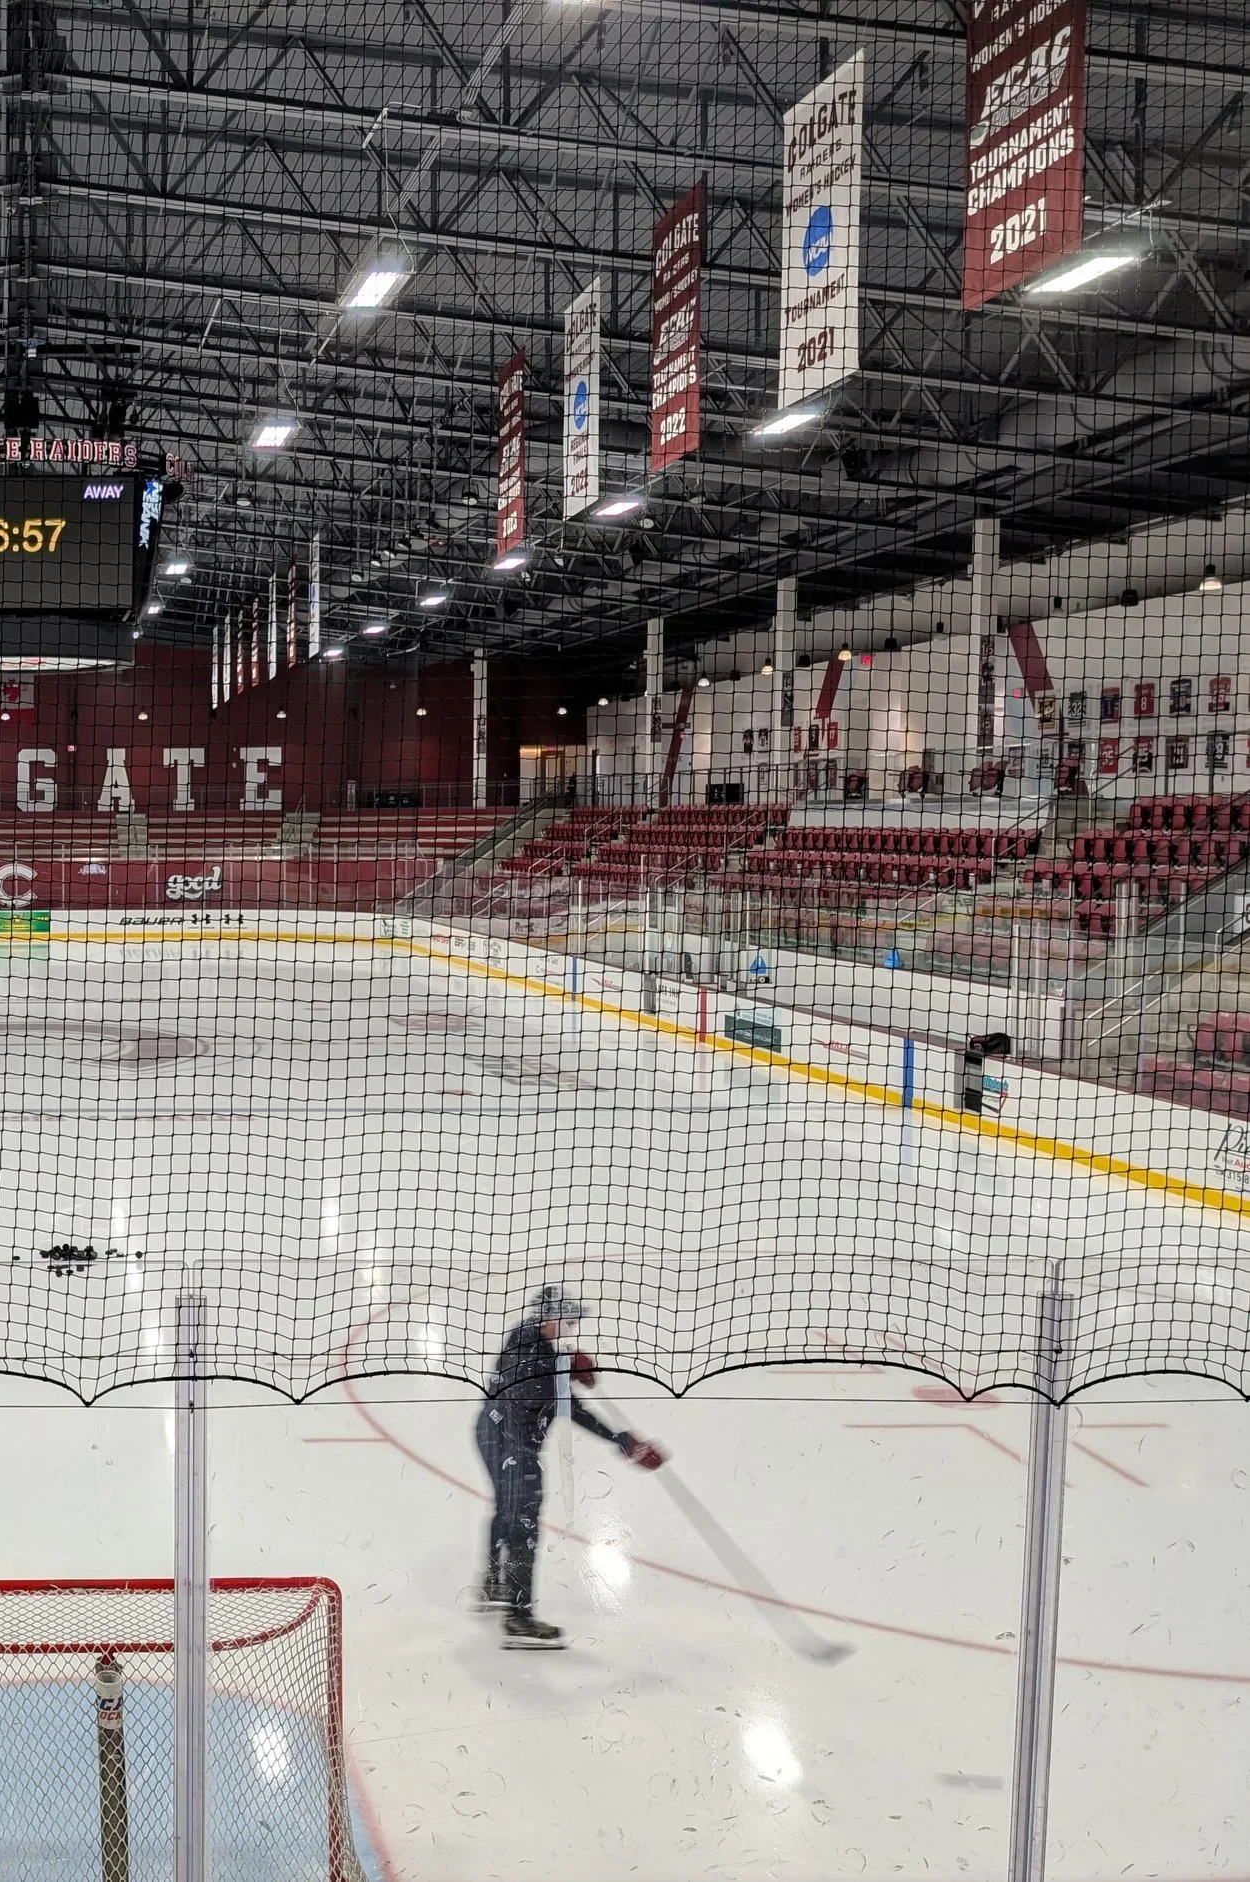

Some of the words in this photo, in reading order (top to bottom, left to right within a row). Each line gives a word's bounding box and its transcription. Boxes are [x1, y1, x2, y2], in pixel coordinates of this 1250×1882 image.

[980, 25, 1073, 120] ECAC
[787, 89, 857, 174] COLGATE
[969, 95, 1074, 185] TOURNAMENT
[967, 125, 1075, 216] CHAMPIONS
[655, 212, 699, 278] COLGATE
[990, 197, 1047, 264] 2021
[784, 273, 846, 326] TOURNAMENT
[797, 326, 835, 374] 2021
[30, 437, 138, 468] RAIDERS
[660, 406, 686, 446] 2022
[83, 484, 124, 499] AWAY
[1141, 696, 1148, 711] 8
[165, 865, 223, 900] good
